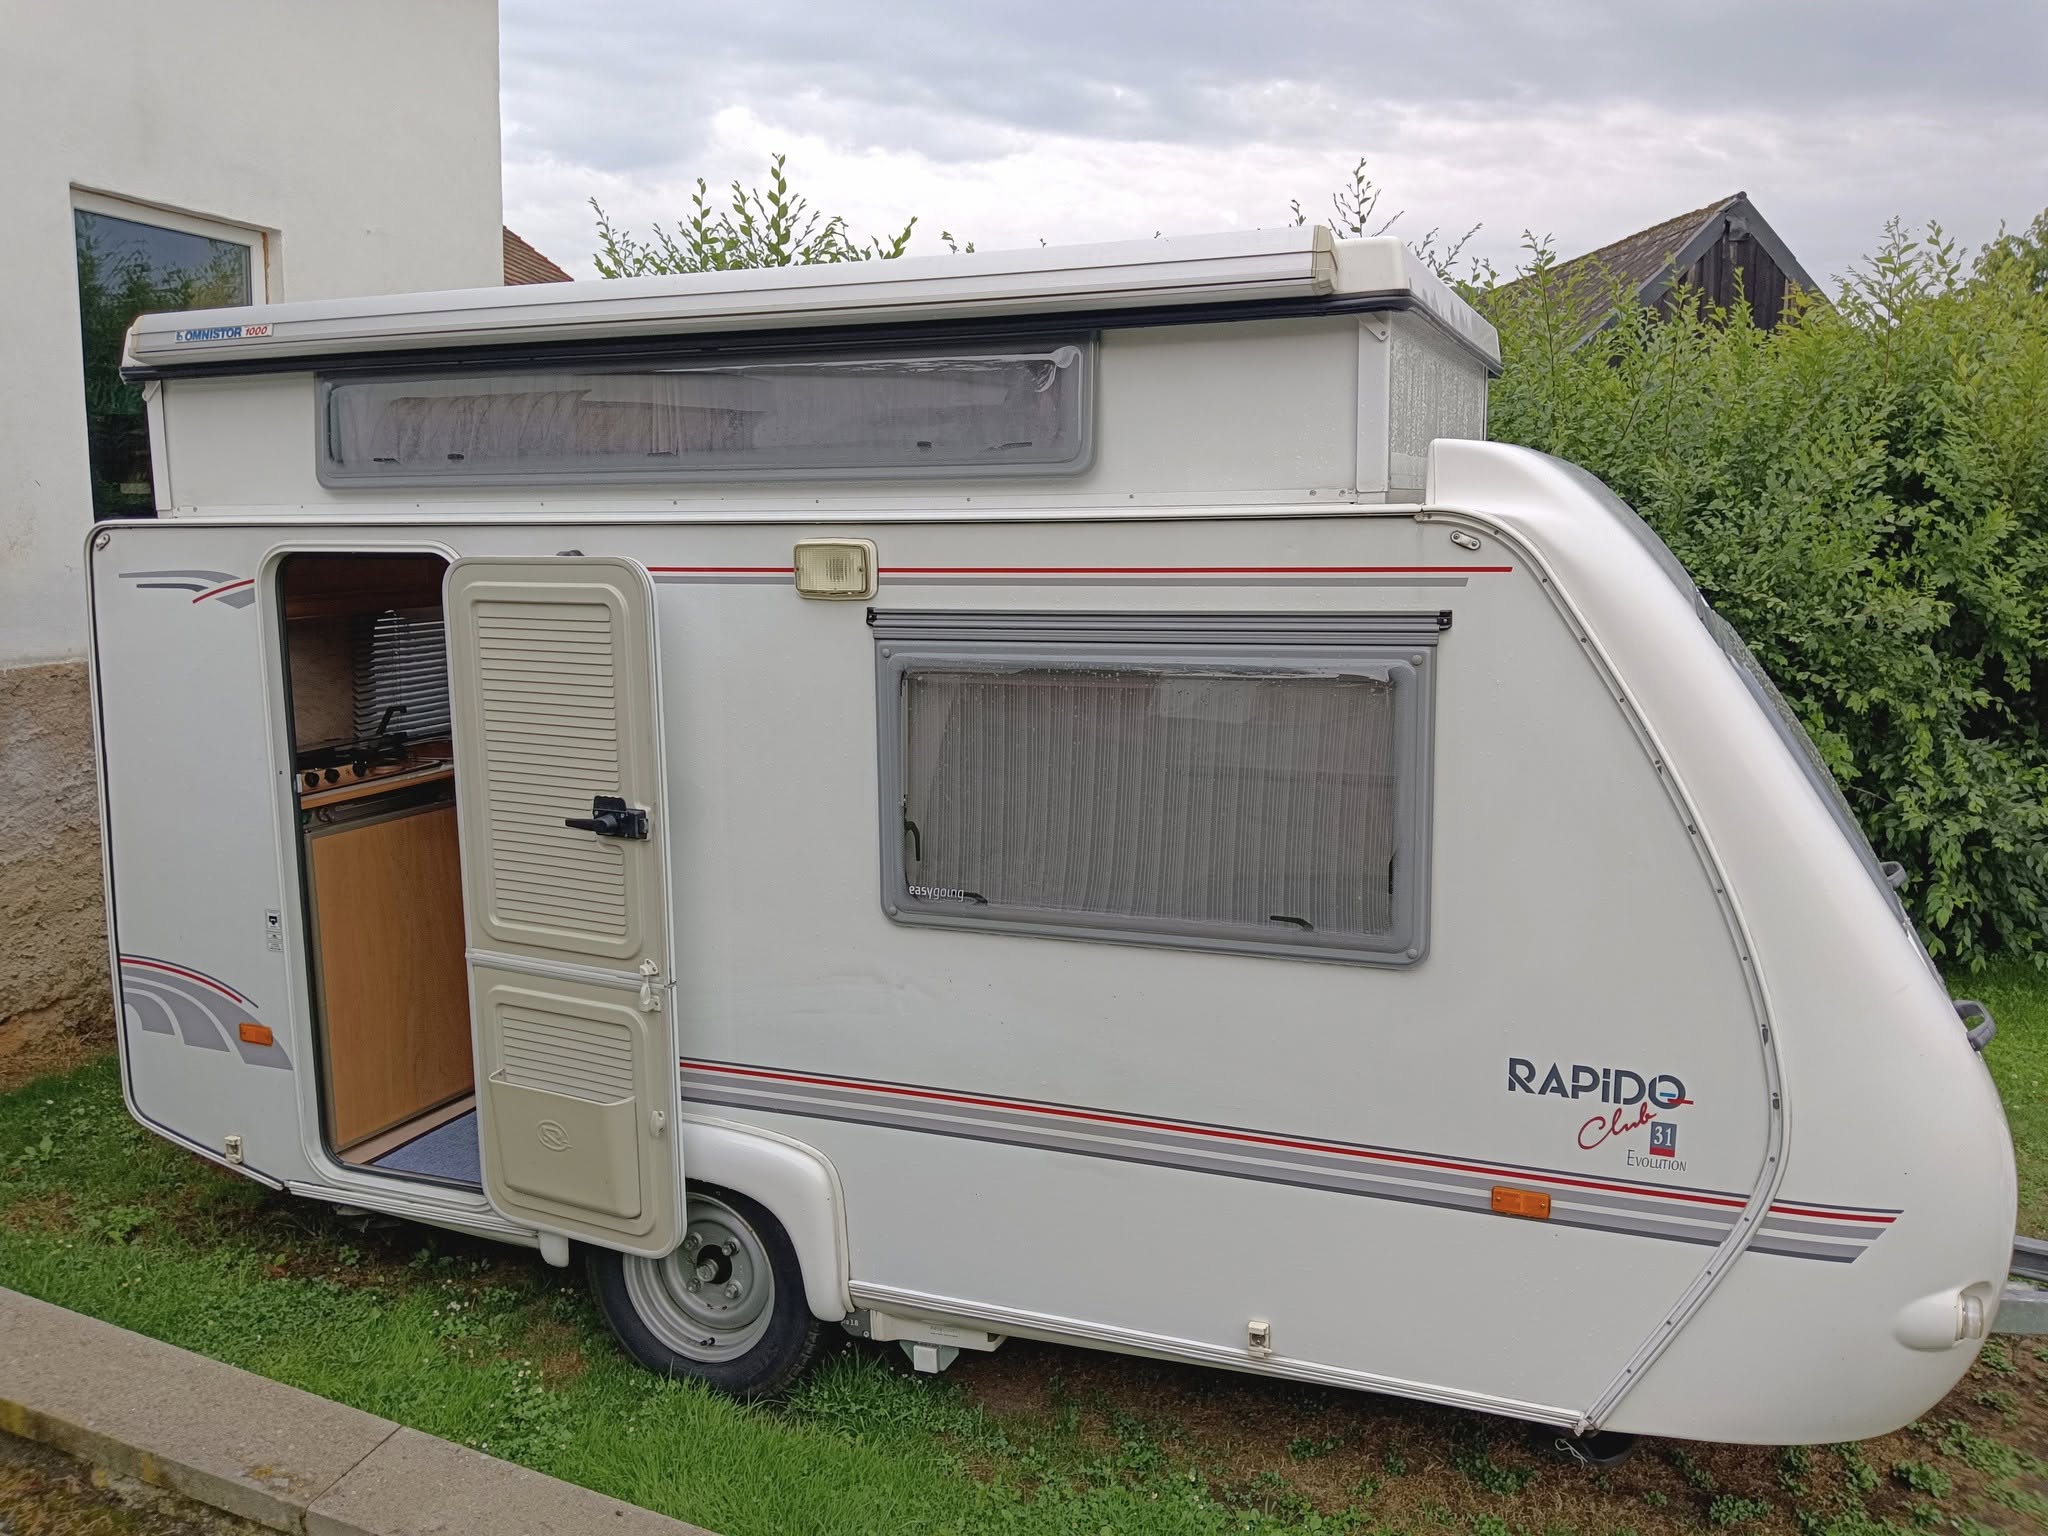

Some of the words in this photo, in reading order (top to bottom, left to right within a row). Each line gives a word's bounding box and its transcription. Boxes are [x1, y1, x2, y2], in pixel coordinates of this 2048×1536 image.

[185, 327, 242, 341] OMNISTOR
[245, 326, 268, 336] 1000
[908, 885, 965, 902] easygoing
[1508, 1057, 1690, 1110] RAPIDO
[1577, 1101, 1658, 1150] Club
[1653, 1125, 1673, 1147] 31
[1626, 1149, 1688, 1173] EVOLUTION
